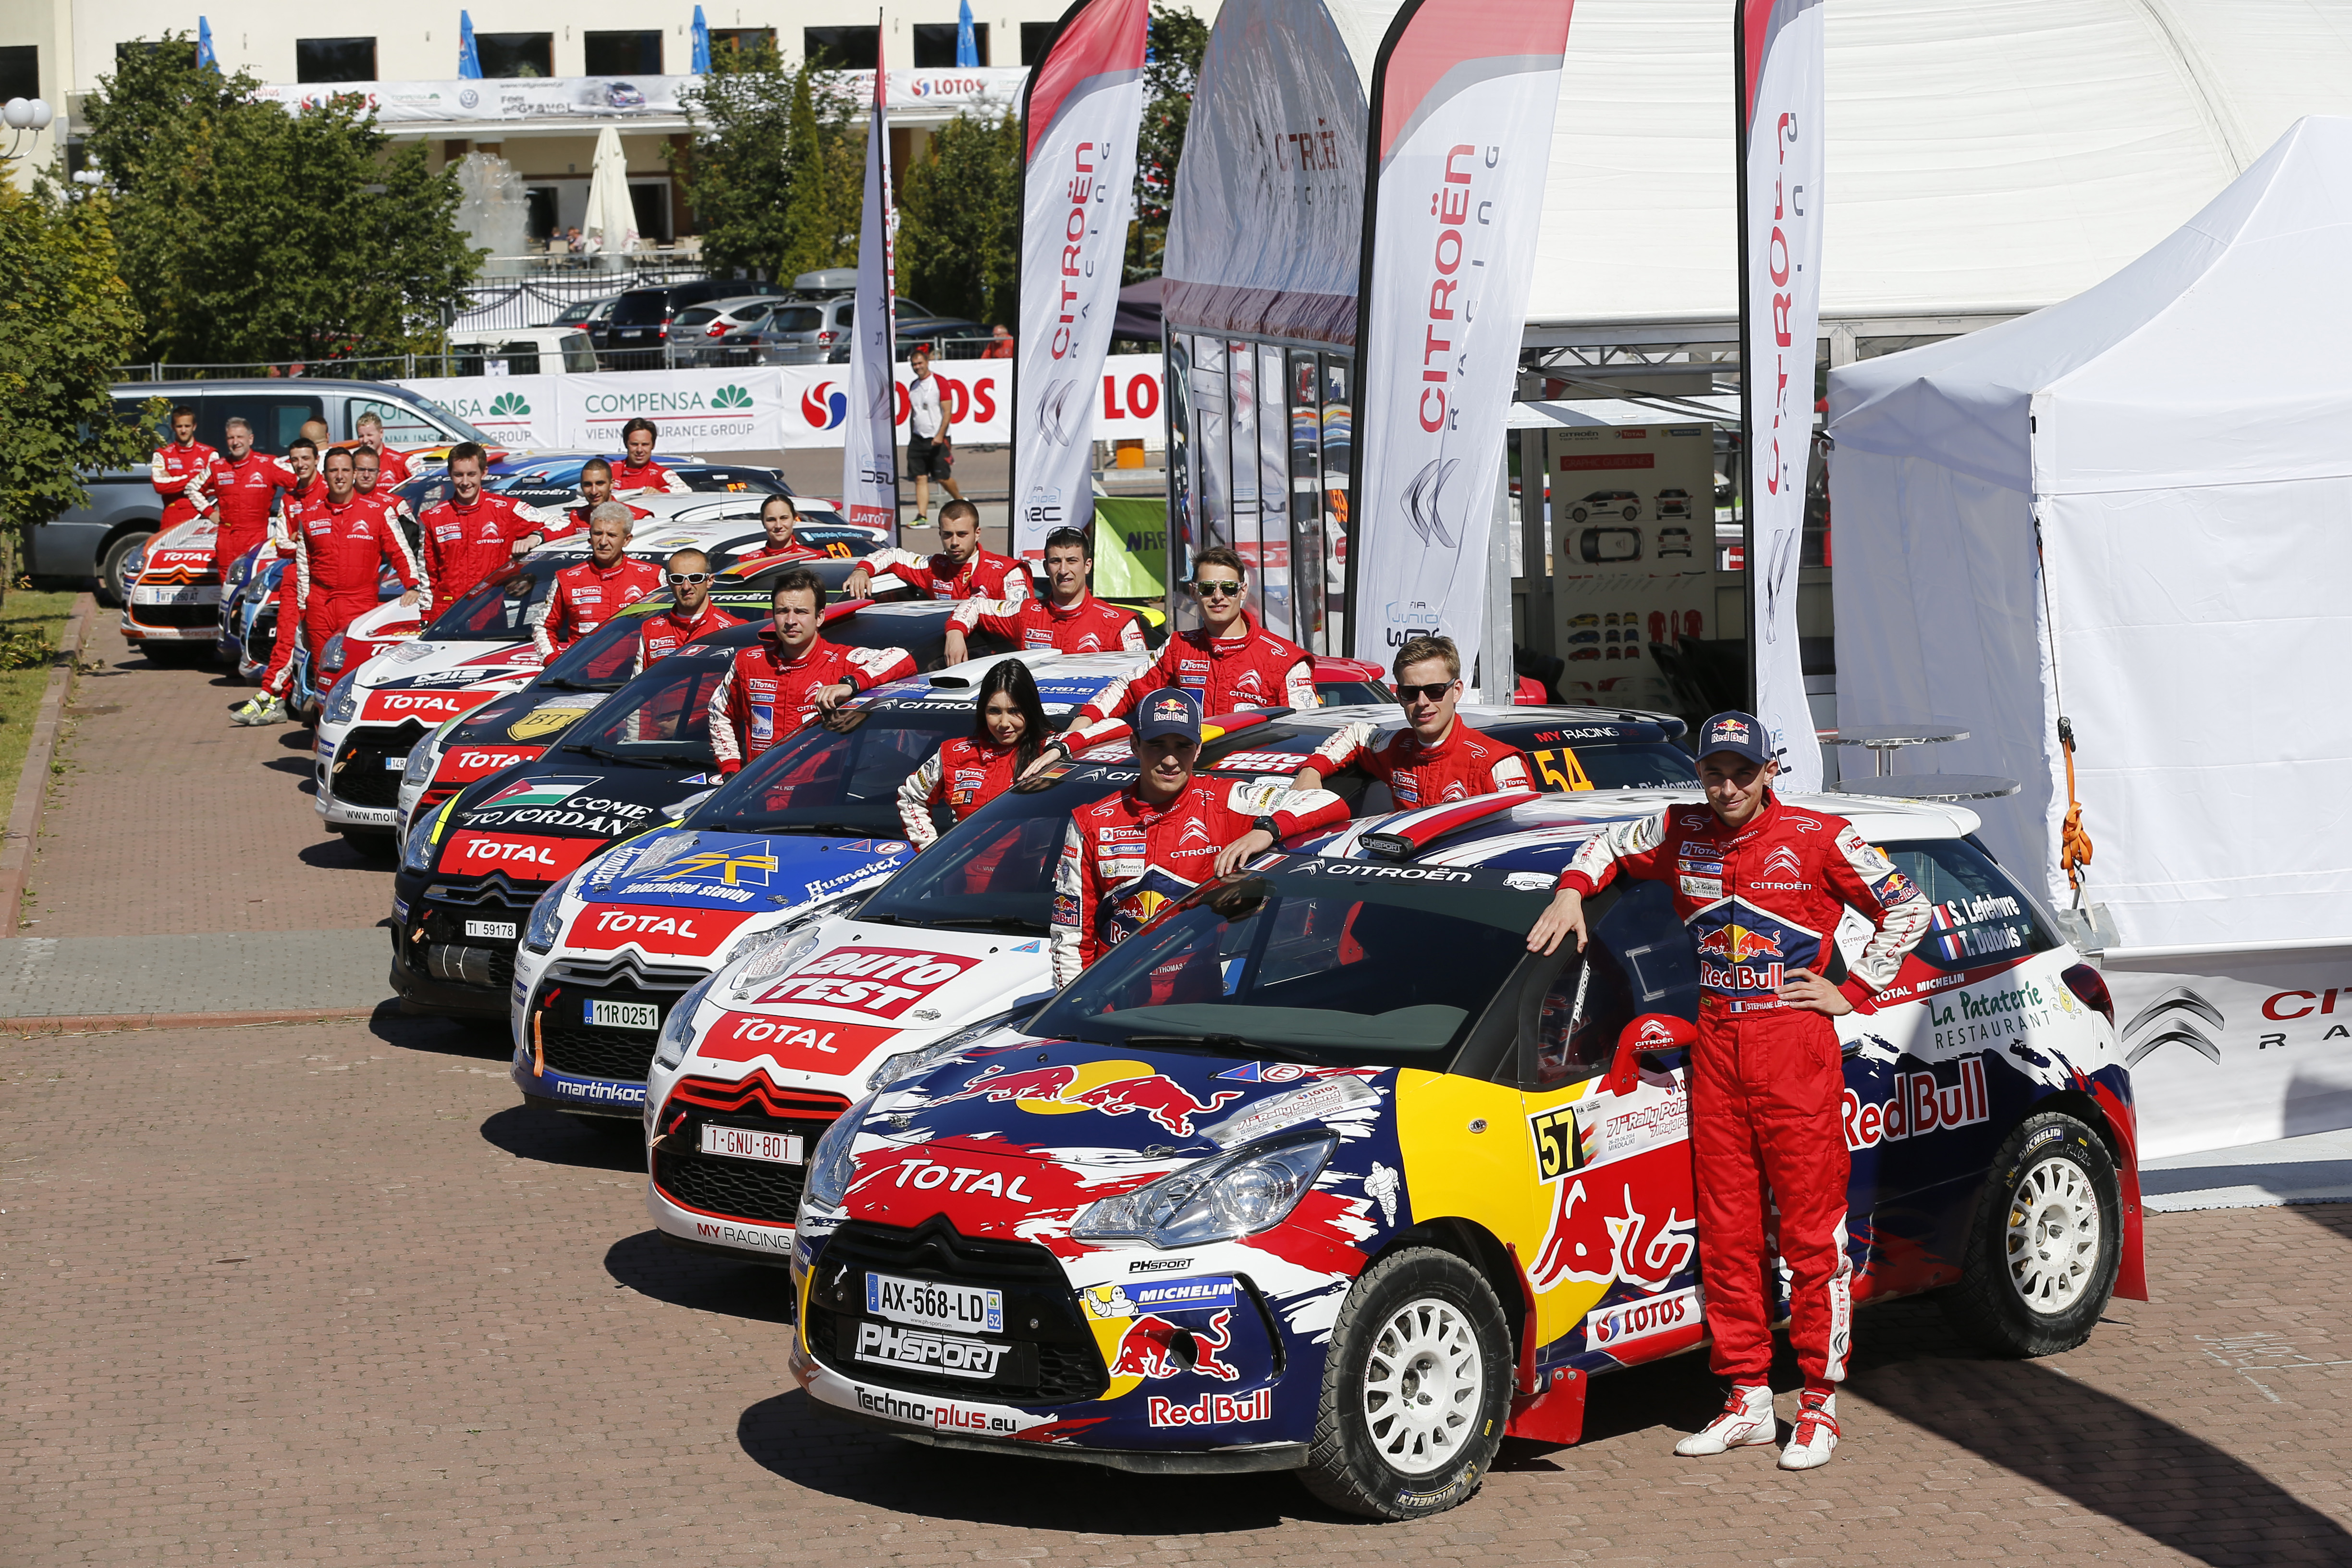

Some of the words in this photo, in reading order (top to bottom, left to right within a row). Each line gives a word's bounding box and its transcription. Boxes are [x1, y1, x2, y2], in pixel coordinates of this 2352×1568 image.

[1069, 142, 1110, 358] RACING
[1447, 145, 1499, 431] RACING
[585, 391, 705, 413] COMPENSA
[586, 427, 625, 440] VIENN
[710, 423, 754, 436] GROUP
[1564, 457, 1601, 468] GRAPHIC
[1603, 456, 1652, 467] GUIDELINES
[163, 552, 212, 562] TOTAL
[1409, 601, 1426, 609] FIA
[1392, 613, 1439, 624] JUNIO
[1034, 630, 1052, 641] TOTAL
[1189, 662, 1208, 670] TOTAL
[409, 678, 480, 688] MOTORSPORT
[384, 694, 461, 711] TOTAL
[525, 712, 572, 726] BT
[1154, 711, 1172, 723] Red
[1172, 711, 1189, 724] Bull
[1533, 730, 1561, 742] MY
[1565, 727, 1618, 740] RACING
[1711, 732, 1729, 744] Red
[1730, 733, 1749, 745] Bull
[1217, 761, 1298, 772] TEST
[1223, 752, 1308, 764] auto
[1398, 774, 1418, 786] TOTAL
[1533, 747, 1595, 792] 54
[565, 796, 654, 820] COME
[463, 813, 496, 826] TO
[494, 809, 637, 836] JORDAN
[1113, 829, 1145, 837] TOTAL
[466, 839, 555, 865] TOTAL
[1692, 845, 1724, 857] TOTAL
[804, 855, 901, 898] Humatex
[1693, 863, 1720, 871] MICHELIN
[697, 884, 756, 904] stavby
[1503, 879, 1553, 890] WRC
[1883, 890, 1907, 907] Red
[1902, 882, 1921, 899] Bull
[1063, 913, 1079, 926] Bull
[1946, 900, 1966, 928] S.
[1968, 894, 2021, 922] Lefebvre
[467, 922, 477, 934] TI
[482, 923, 514, 936] 59178
[596, 910, 698, 939] TOTAL
[1959, 932, 1976, 956] T.
[1976, 923, 2021, 954] Dubois
[796, 951, 961, 986] auto
[1158, 963, 1183, 974] THOMAS
[1701, 961, 1735, 990] Red
[1736, 963, 1785, 990] Bull
[766, 978, 922, 1010] TEST
[1874, 986, 1912, 1003] TOTAL
[1916, 972, 1965, 992] MICHELIN
[1747, 1002, 1774, 1010] STEPHANE
[1930, 993, 1955, 1027] La
[1959, 980, 2043, 1018] Pataterie
[596, 1004, 619, 1024] 11R
[622, 1005, 656, 1026] 0251
[731, 1017, 839, 1054] TOTAL
[1935, 1010, 2051, 1050] RESTAURANT
[1308, 1085, 1338, 1097] LOTOS
[1257, 1105, 1295, 1123] Rally
[1291, 1090, 1341, 1113] Poland
[1842, 1072, 1909, 1152] Red
[1909, 1056, 1990, 1137] Bull
[1627, 1106, 1659, 1132] Rally
[1659, 1122, 1677, 1135] Rajd
[711, 1128, 790, 1157] 1-GNU-801
[1536, 1109, 1574, 1176] 57
[1607, 1138, 1636, 1152] MIKOŁAJKI
[895, 1159, 1034, 1205] TOTAL
[697, 1222, 720, 1239] MY
[723, 1227, 792, 1250] RACING
[1138, 1281, 1234, 1303] MICHELIN
[870, 1297, 876, 1306] F
[882, 1280, 983, 1323] AX-568-LD
[987, 1312, 1001, 1329] 52
[1623, 1296, 1686, 1335] LOTOS
[909, 1318, 953, 1329] www.ph-sport.com
[854, 1385, 1017, 1433] Techno-plus.eu
[1148, 1392, 1213, 1427] Red
[1212, 1387, 1272, 1424] Bull
